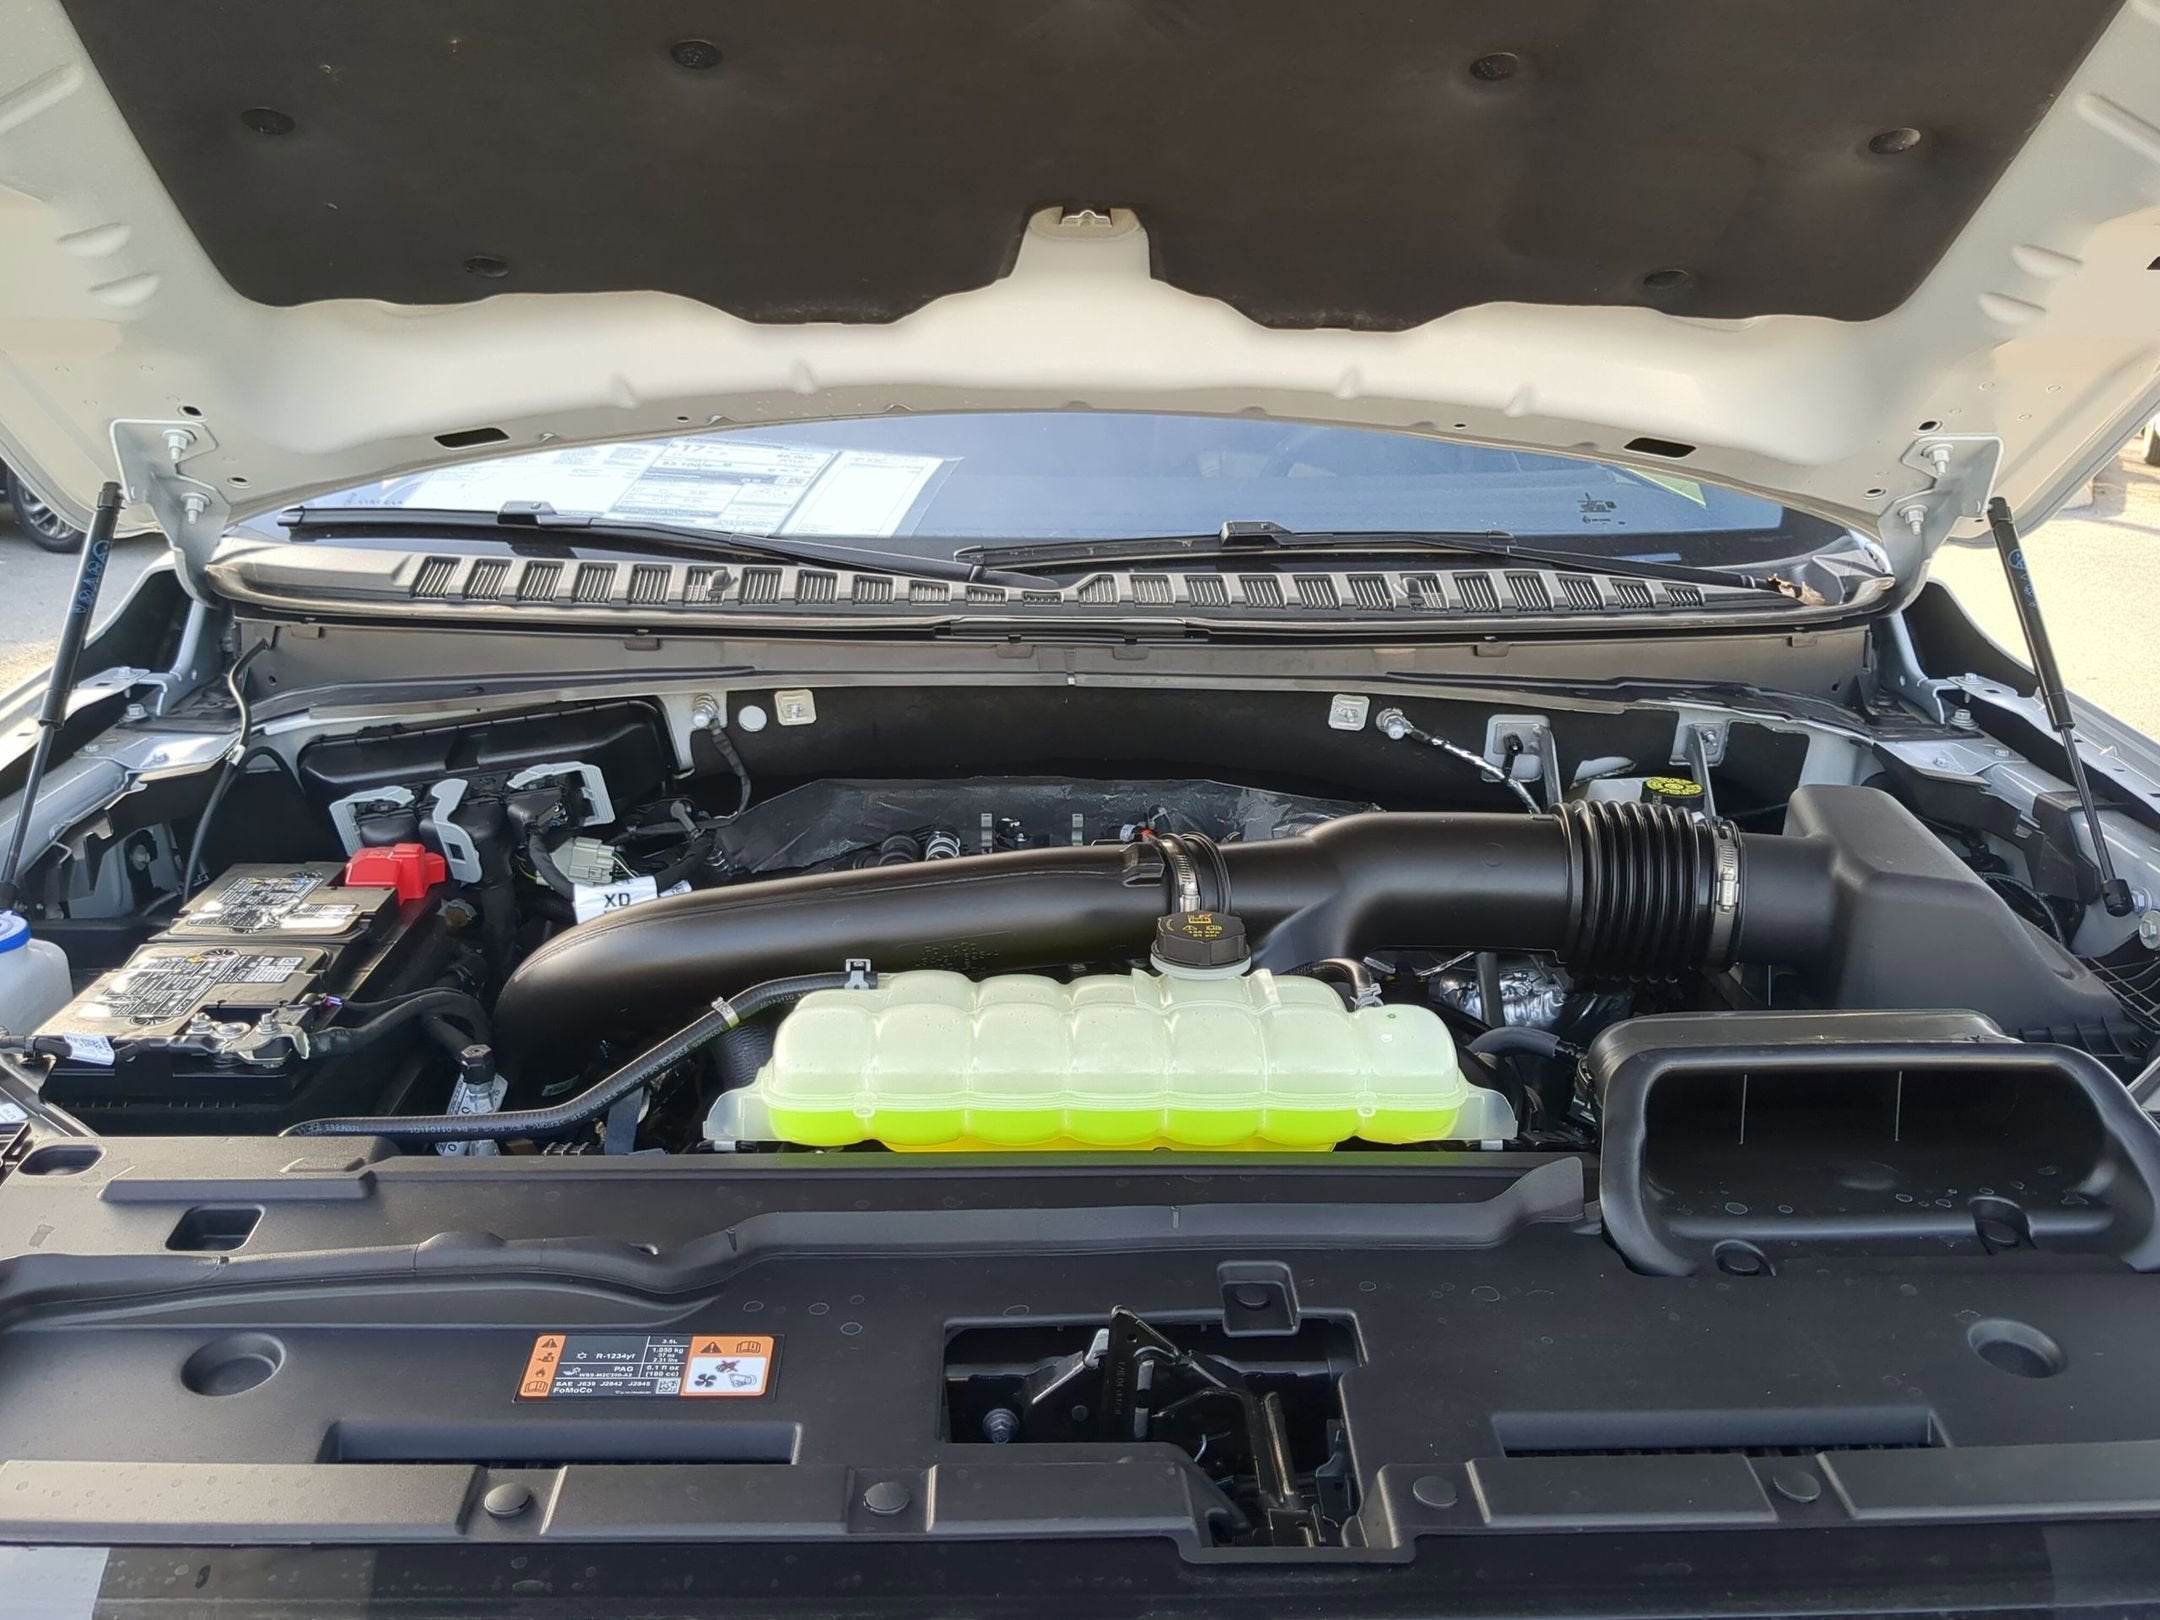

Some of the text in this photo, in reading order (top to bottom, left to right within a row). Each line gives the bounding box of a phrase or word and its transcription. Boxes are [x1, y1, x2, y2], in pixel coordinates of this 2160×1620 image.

[604, 892, 631, 908] XD
[674, 1347, 684, 1355] kg
[595, 1353, 636, 1361] R-1234yf
